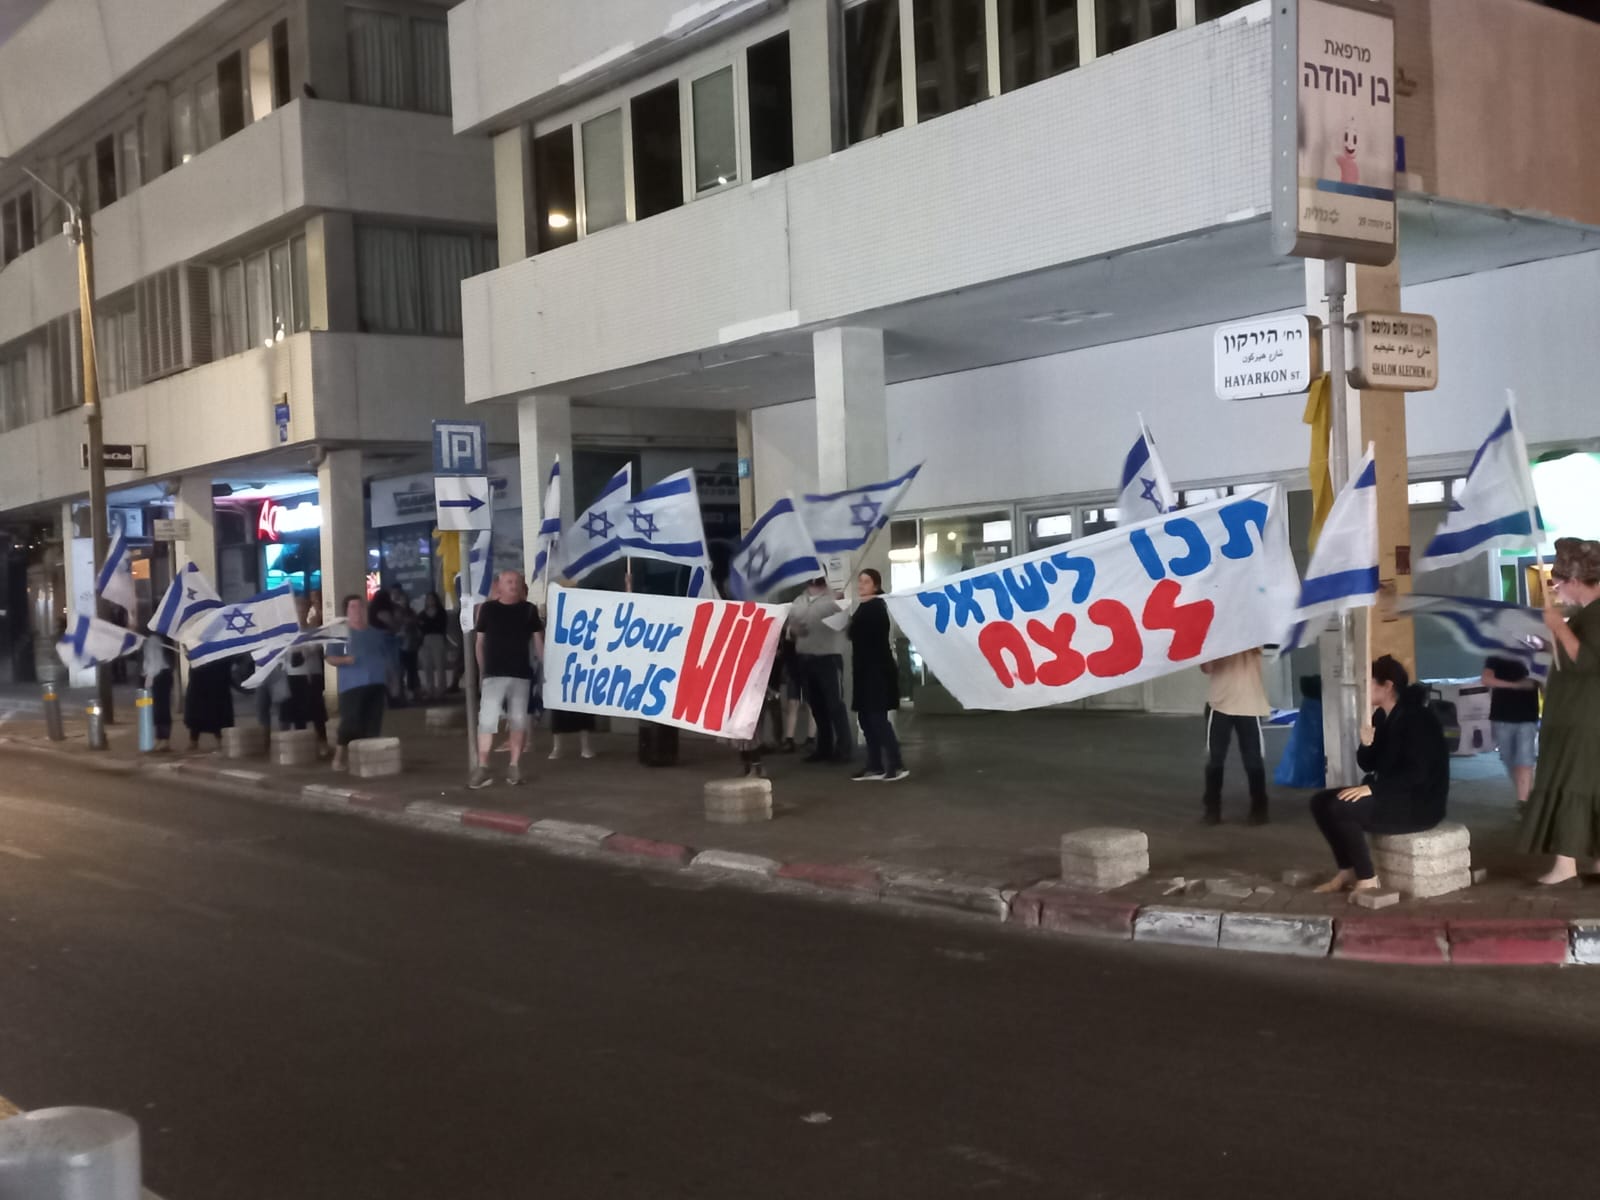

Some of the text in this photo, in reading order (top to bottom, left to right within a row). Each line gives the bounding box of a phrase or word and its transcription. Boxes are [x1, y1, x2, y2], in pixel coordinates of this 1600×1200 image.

[1324, 39, 1371, 63] מרפאת
[1304, 62, 1362, 96] יהודה
[1371, 75, 1390, 106] בן
[1224, 329, 1278, 354] הירקון
[1225, 369, 1287, 388] HAYARKON
[917, 552, 1096, 634] לישראל
[555, 592, 602, 651] Let
[561, 652, 676, 716] friends
